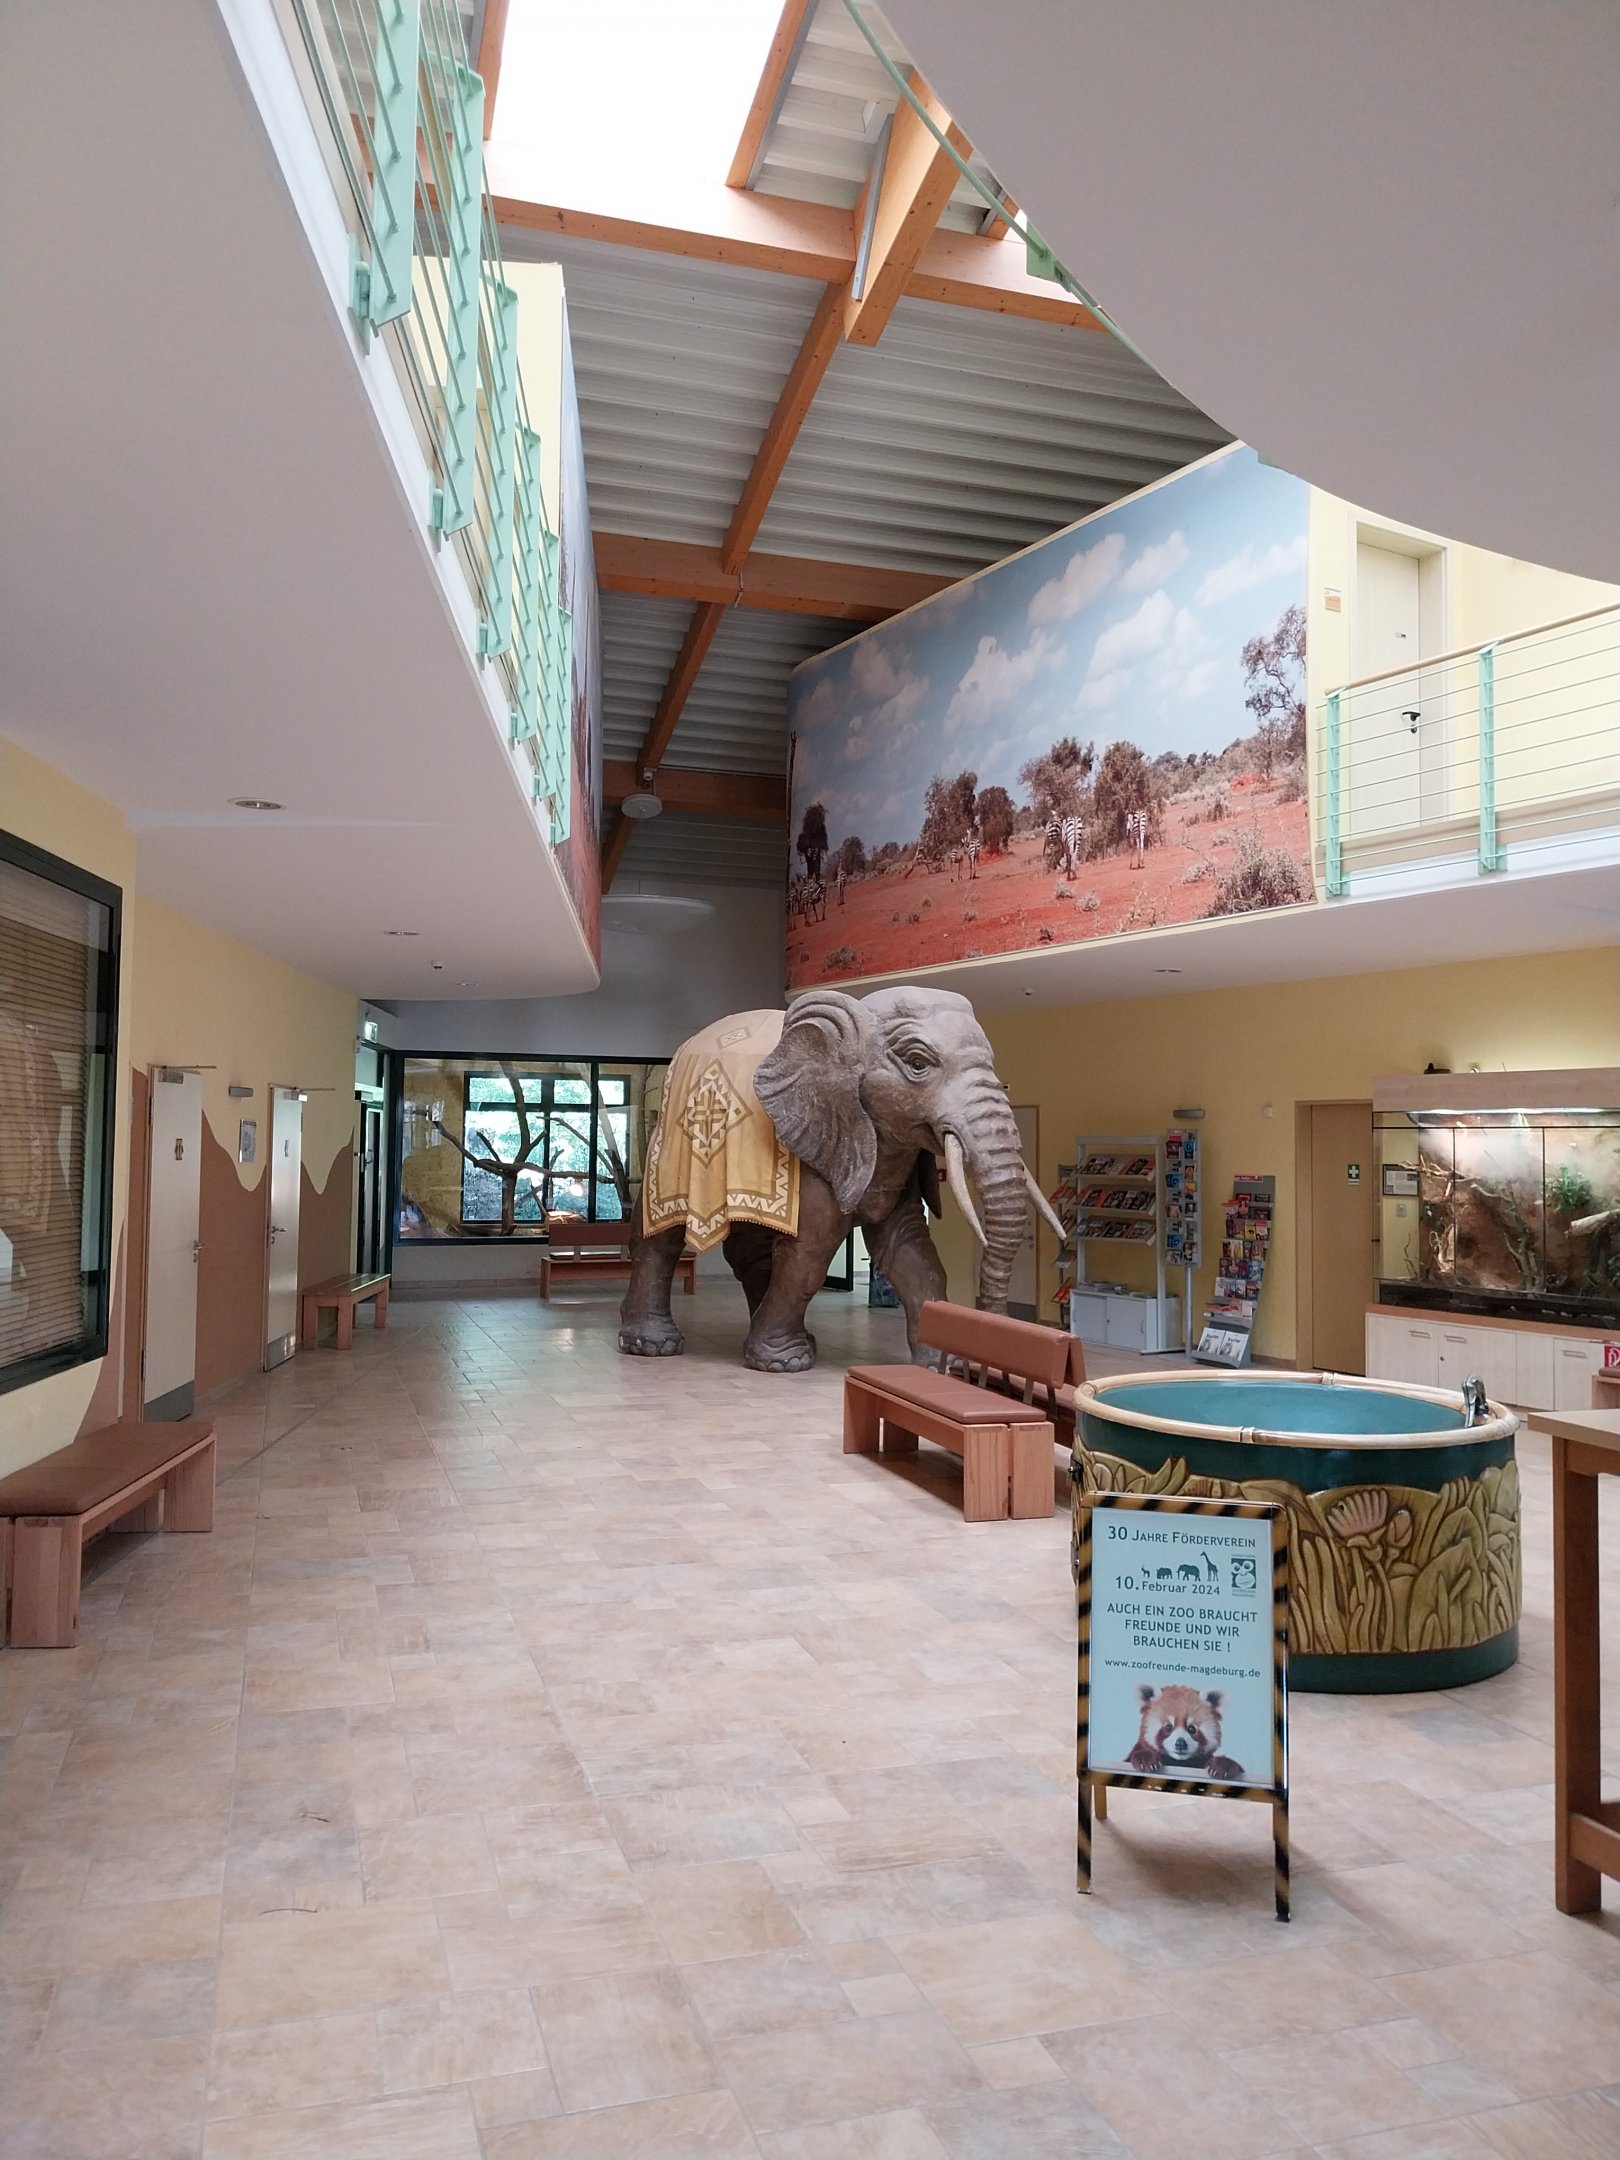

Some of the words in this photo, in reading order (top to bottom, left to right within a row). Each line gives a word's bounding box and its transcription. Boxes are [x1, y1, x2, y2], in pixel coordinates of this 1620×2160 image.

[1108, 1526, 1127, 1540] 30
[1115, 1576, 1139, 1590] 10.
[1142, 1581, 1187, 1593] Februar
[1192, 1584, 1220, 1595] 2024
[1107, 1603, 1140, 1614] AUCH
[1145, 1605, 1164, 1616] EIN
[1169, 1607, 1194, 1618] ZOO
[1200, 1609, 1258, 1622] BRAUCHT
[1125, 1620, 1180, 1633] FREUNDE
[1186, 1624, 1211, 1635] UND
[1216, 1626, 1240, 1637] WIR
[1133, 1636, 1199, 1650] BRAUCHEN
[1204, 1641, 1222, 1651] SIE
[1105, 1659, 1261, 1678] www.zoofreunde-magdeburg.de
